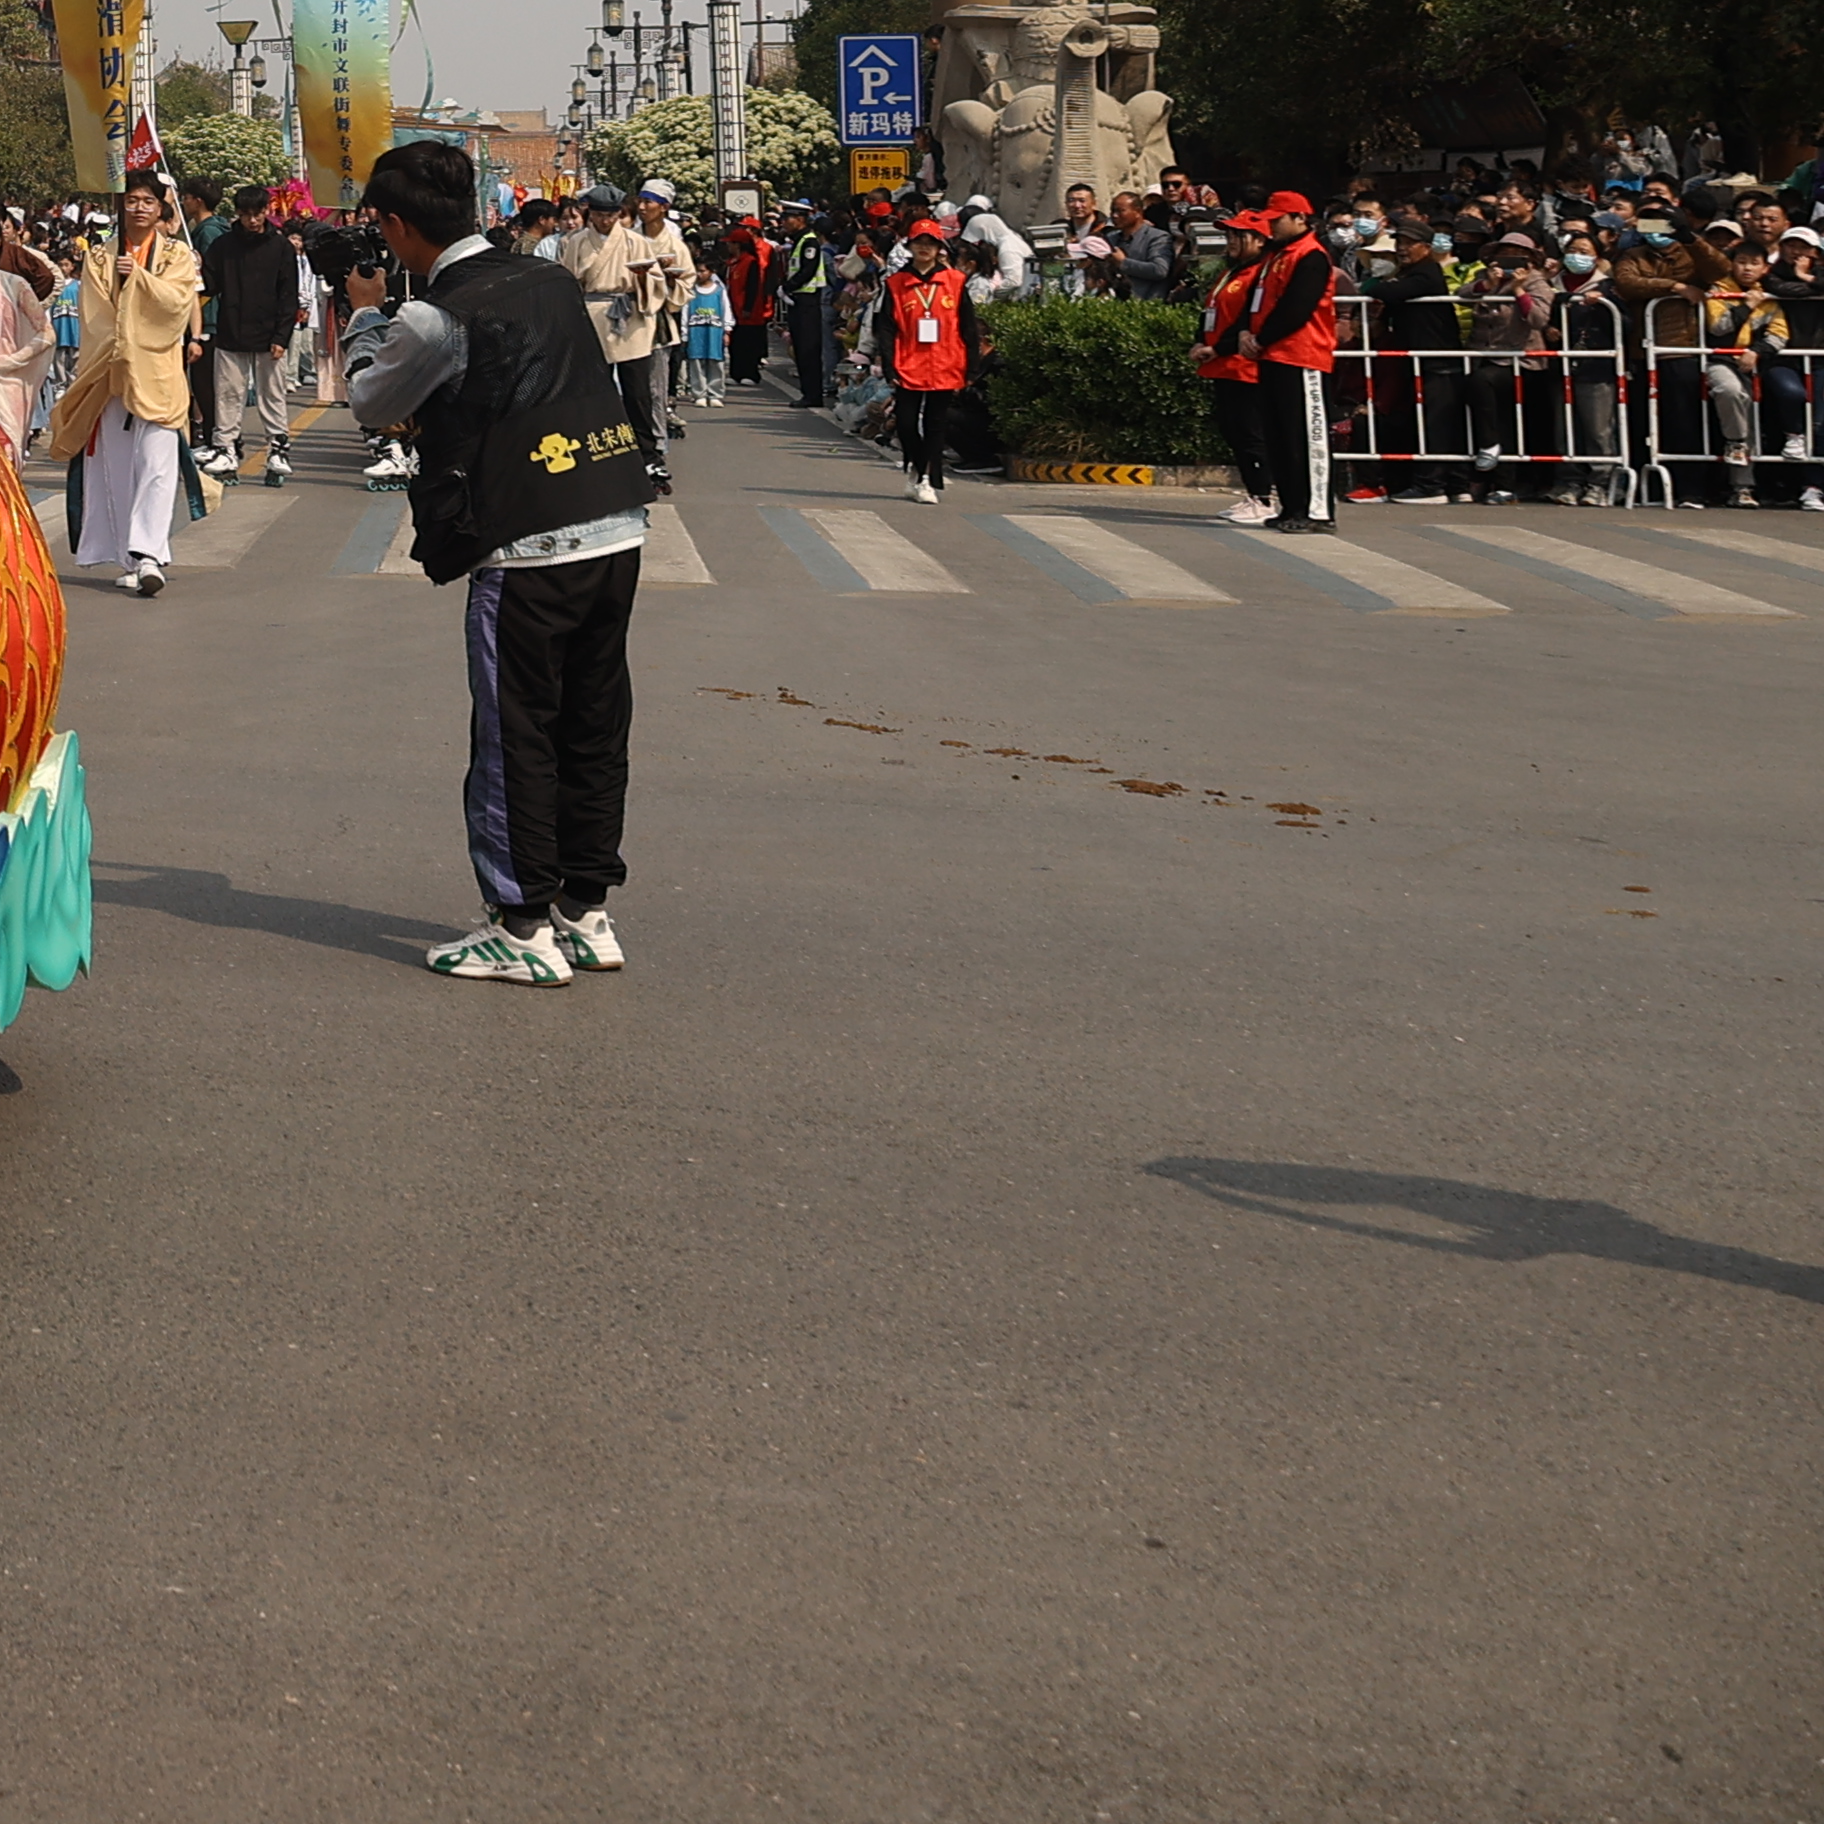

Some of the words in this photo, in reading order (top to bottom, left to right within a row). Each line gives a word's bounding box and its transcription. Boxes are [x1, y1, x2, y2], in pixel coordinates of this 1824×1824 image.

[332, 0, 354, 191] 开封市文联街舞专委会
[857, 67, 890, 105] P
[848, 111, 913, 136] 新玛特
